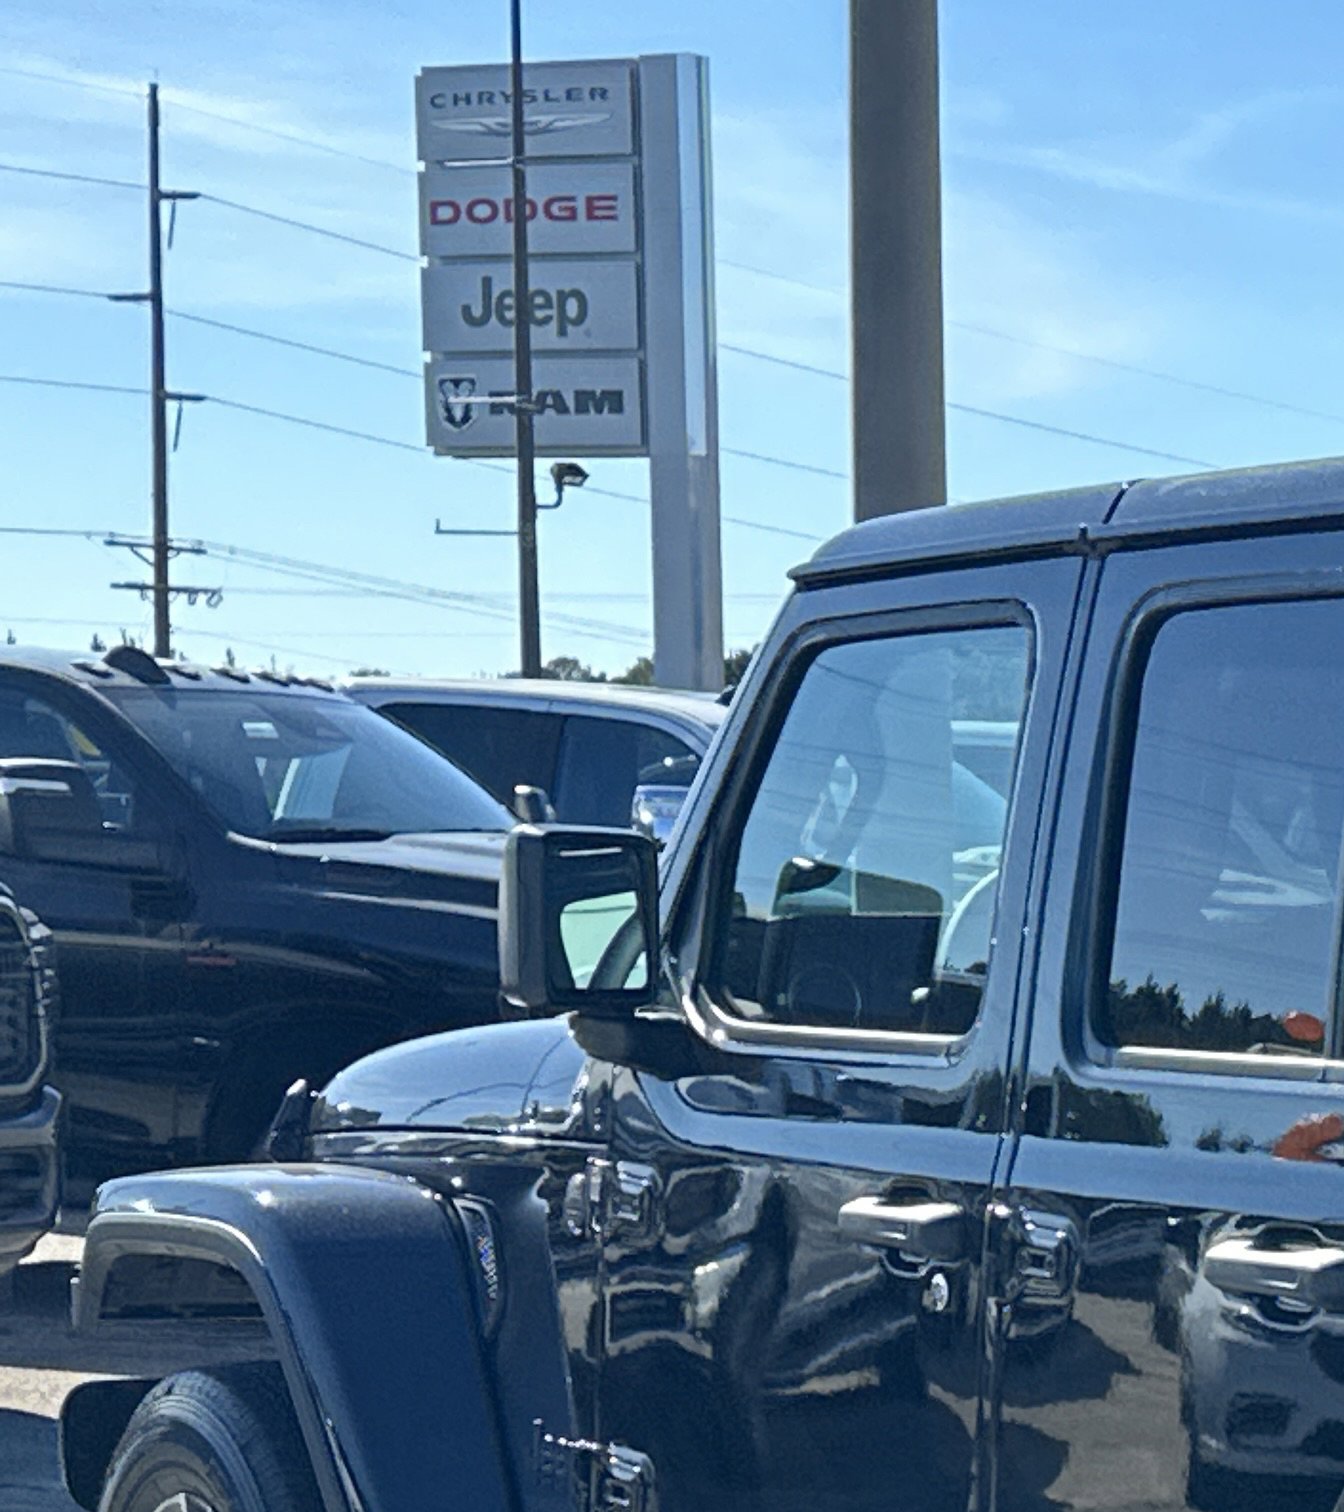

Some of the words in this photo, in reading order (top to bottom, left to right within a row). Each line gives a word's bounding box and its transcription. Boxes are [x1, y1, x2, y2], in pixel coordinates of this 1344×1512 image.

[430, 87, 610, 108] CHRYSLER
[429, 195, 619, 225] DODGE
[461, 276, 588, 337] Jeep
